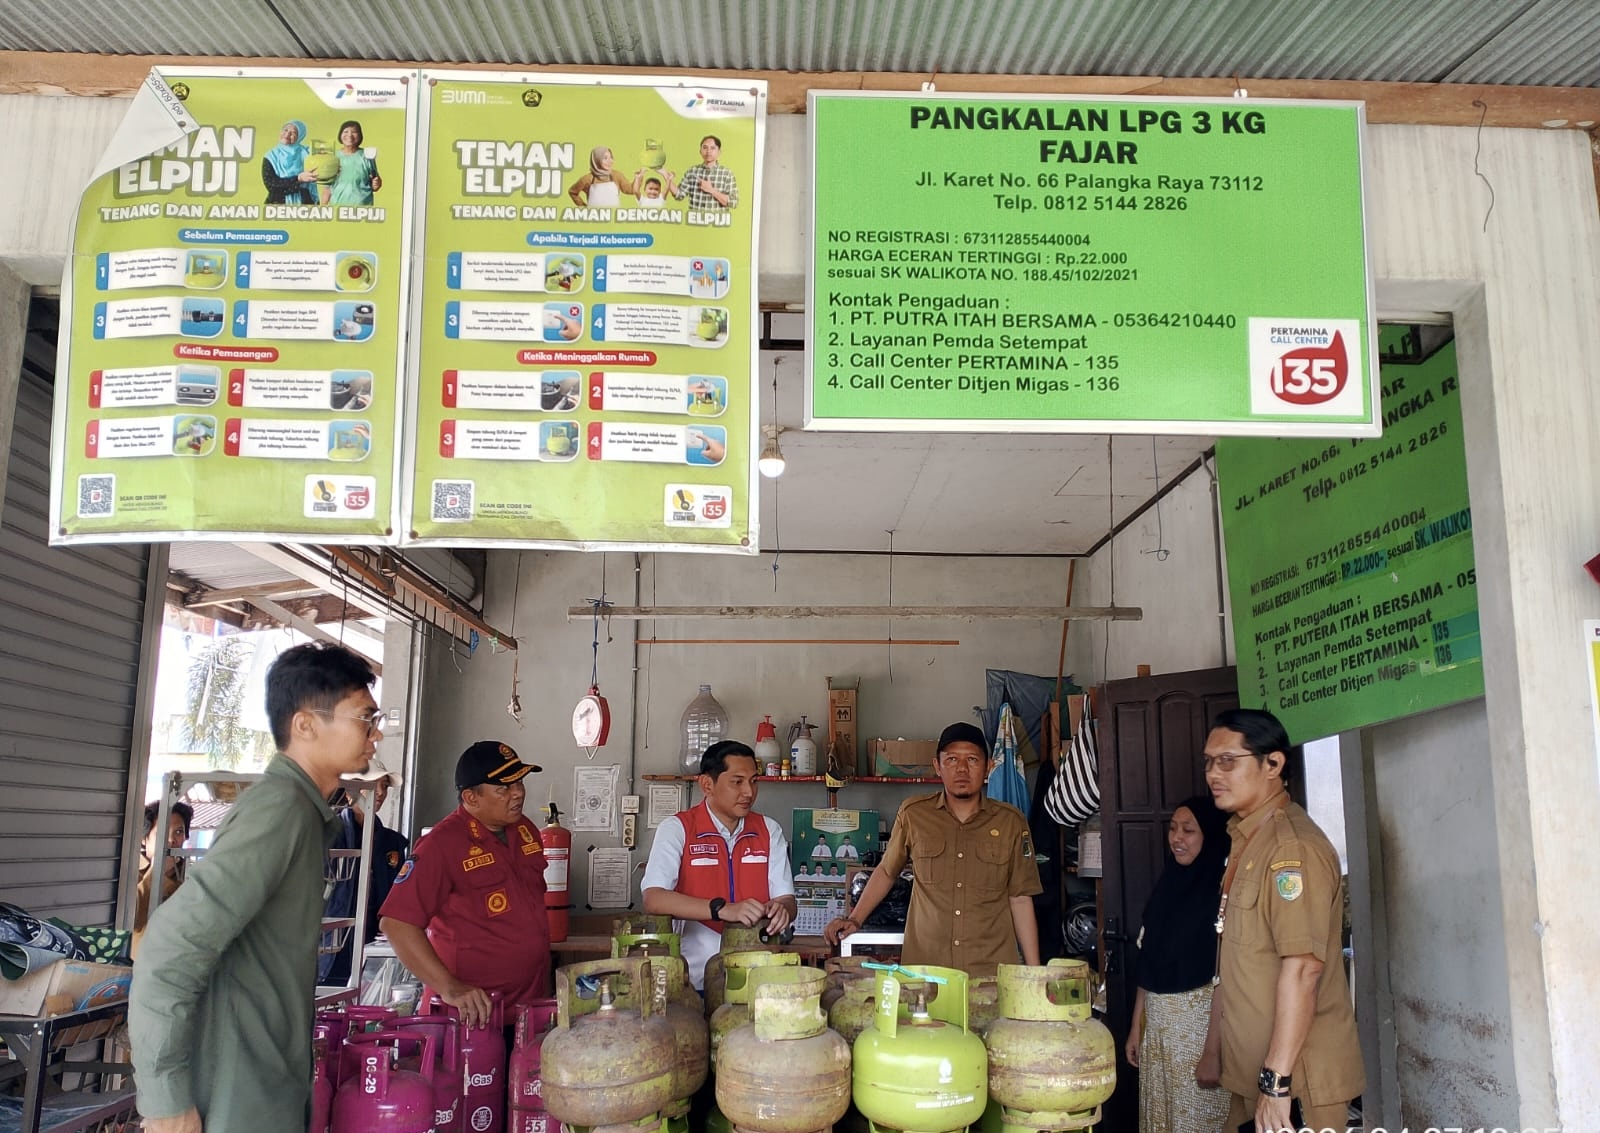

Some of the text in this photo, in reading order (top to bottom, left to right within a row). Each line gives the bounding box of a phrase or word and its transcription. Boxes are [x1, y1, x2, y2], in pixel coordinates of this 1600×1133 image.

[357, 89, 396, 97] PERTAMINA
[706, 99, 745, 108] PERTAMINA
[911, 107, 1265, 134] PANGKALAN LPG 3 KG
[456, 141, 574, 169] TEMAN
[1040, 141, 1137, 164] FAJAR
[119, 160, 237, 194] ELPIJI
[466, 169, 561, 195] ELPIJI
[916, 172, 1263, 193] Jl. Karet No. 66 Palangka Raya 73112
[994, 195, 1187, 213] Telp. 0812 5144 2826
[101, 203, 386, 221] TENANG DAN AMAN DENGAN ELPIJI
[452, 205, 730, 225] TENANG DAN AMAN DENGAN ELPIJI
[184, 231, 283, 242] Sebelum Pemasangan
[533, 234, 567, 243] Apabila
[568, 234, 598, 246] Terjadi
[829, 231, 1090, 245] NO REGISTRASI 673112855440004
[829, 250, 1127, 267] HARGA ECERAN TERTINGGI Rp.22.000
[101, 267, 105, 277] 1
[239, 265, 248, 275] 2
[452, 266, 457, 276] 1
[596, 269, 604, 279] 2
[828, 267, 1137, 281] sesuai SK WALIKOTA NO. 188.45/102/2021
[830, 293, 998, 311] Kontak Pengaduan
[97, 316, 104, 326] 3
[236, 314, 245, 325] 4
[449, 315, 456, 325] 3
[594, 318, 603, 328] 4
[830, 312, 1235, 328] 1. PT. PUTRA ITAH BERSAMA 05364210440
[829, 332, 1087, 352] 2. Layanan Pemda Setempat
[1271, 336, 1296, 344] CALL
[180, 346, 272, 360] Ketika Pemasangan
[524, 352, 552, 360] Ketika
[554, 352, 616, 363] Meninggalkan
[829, 353, 1118, 370] 3. Call Center PERTAMINA 135
[1274, 358, 1338, 395] 135
[93, 385, 98, 395] 1
[232, 383, 241, 393] 2
[447, 384, 452, 394] 1
[593, 386, 601, 397] 2
[828, 375, 1119, 394] 4. Call Center Ditjen Migas 136
[88, 435, 96, 444] 3
[228, 432, 238, 443] 4
[444, 434, 452, 445] 3
[591, 437, 599, 447] 4
[1303, 422, 1447, 502] Telp. 0812 5144 2826
[1235, 495, 1254, 510] JL.
[1259, 468, 1296, 497] KARET
[345, 493, 367, 507] 135
[703, 503, 723, 517] 135
[1251, 585, 1261, 595] NO
[1307, 508, 1426, 570] 673112855440004
[1252, 600, 1274, 617] HARGA
[1275, 590, 1301, 609] ECERAN
[1387, 536, 1414, 560] sesuai
[1414, 530, 1430, 550] SK.
[1255, 598, 1353, 645] Kontak Pengaduan
[1257, 651, 1265, 662] 1.
[1274, 641, 1290, 657] PT.
[1293, 623, 1337, 650] PUTERA
[1341, 609, 1369, 631] ITAH
[1374, 582, 1443, 619] BERSAMA
[1259, 609, 1432, 680] 2. Layanan Pemda Setempat
[1260, 623, 1449, 697] 3. Call Center PERTAMINA 135
[1280, 692, 1299, 709] Call
[1302, 683, 1337, 703] Center
[1341, 673, 1374, 692] Ditjen
[1378, 660, 1416, 681] Migas
[1435, 644, 1452, 665] 136
[472, 1074, 493, 1087] Gas
